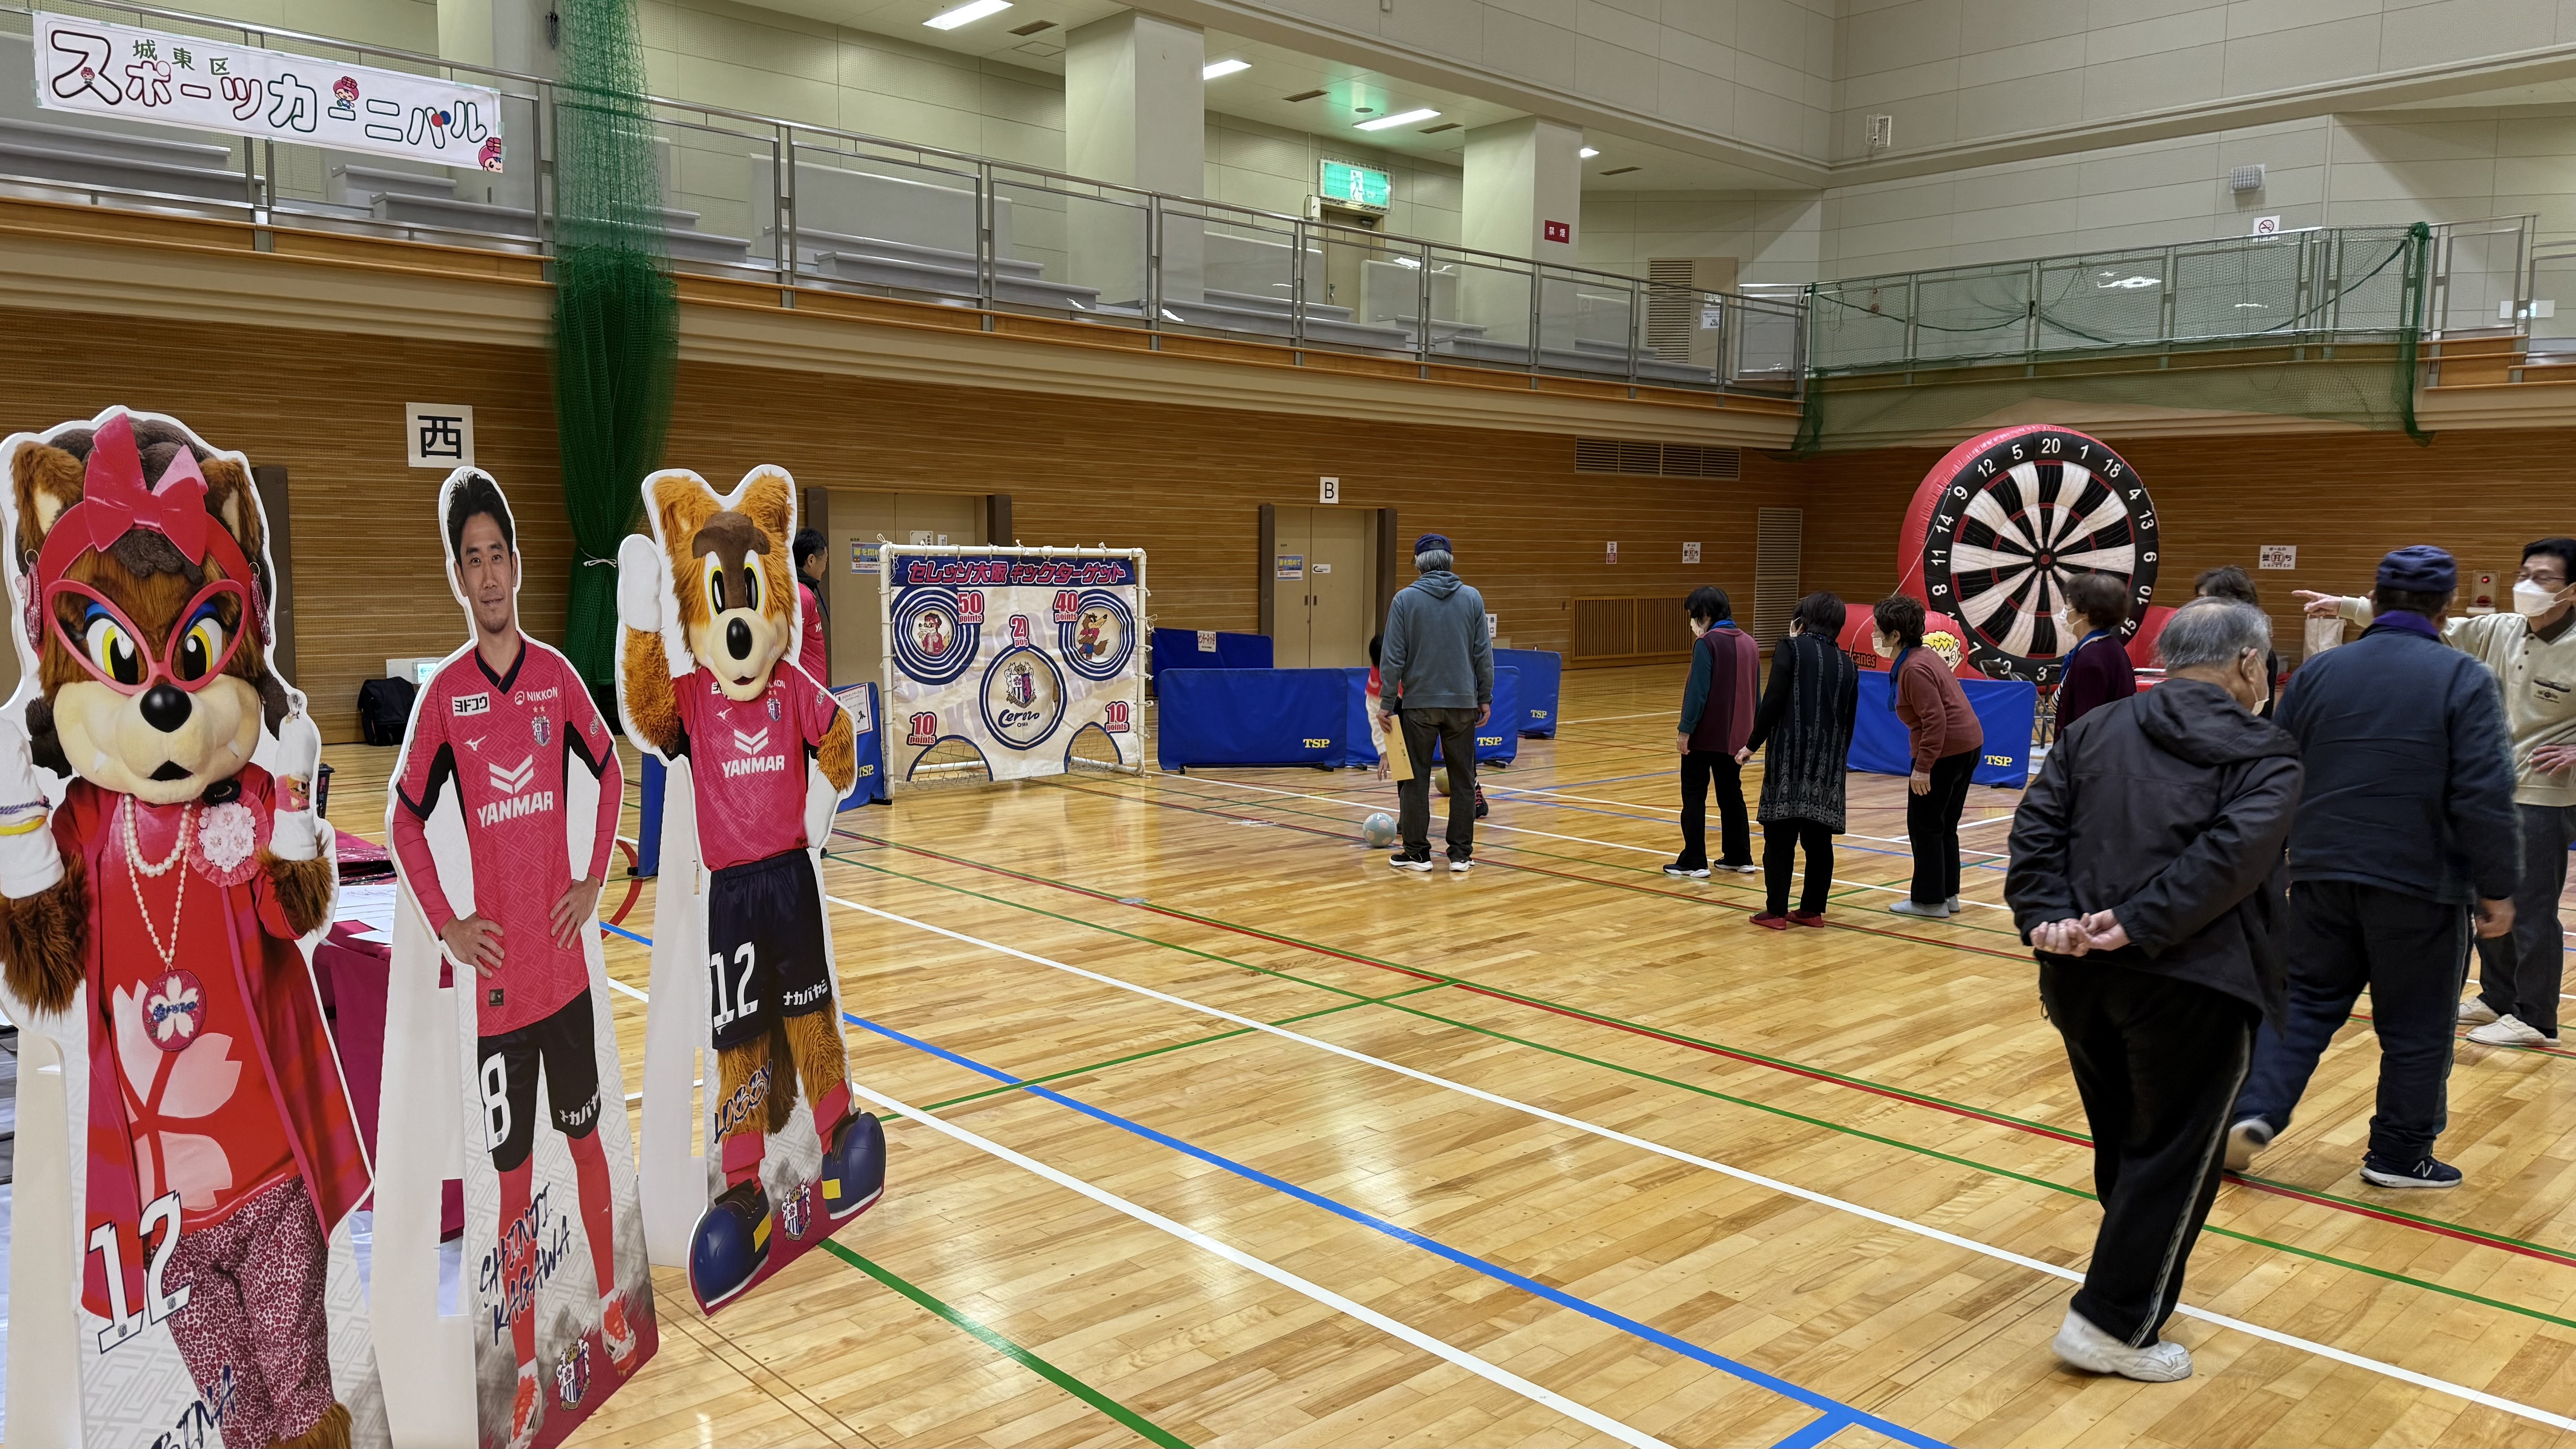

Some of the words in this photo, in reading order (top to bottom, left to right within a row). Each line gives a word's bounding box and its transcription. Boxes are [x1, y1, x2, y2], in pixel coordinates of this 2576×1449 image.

[133, 39, 230, 76] 城東区
[418, 415, 462, 459] 西
[2012, 445, 2024, 459] 5
[2042, 438, 2061, 454] 20
[2080, 445, 2088, 460] 1
[1978, 460, 1996, 478] 12
[2104, 459, 2121, 478] 18
[1325, 482, 1334, 499] B
[1954, 486, 1968, 500] 9
[2128, 488, 2141, 500] 4
[1936, 514, 1954, 534] 14
[2140, 511, 2153, 529] 13
[1932, 550, 1946, 565] 11
[2144, 552, 2157, 563] 6
[1010, 561, 1125, 584] キックターゲット
[1932, 584, 1947, 595] 8
[2137, 586, 2151, 604] 10
[957, 592, 982, 614] 50
[1054, 592, 1078, 613] 40
[959, 614, 982, 623] points
[1055, 612, 1077, 621] points
[2121, 618, 2137, 636] 15
[1968, 642, 1982, 654] 7
[2037, 667, 2047, 681] 3
[527, 686, 558, 702] NIKKON
[455, 696, 488, 713] ヨドコウ
[1106, 703, 1127, 723] 10
[998, 709, 1040, 728] Cerezo
[1531, 709, 1547, 718] TSP
[912, 714, 935, 736] 10
[1106, 723, 1128, 731] points
[910, 736, 935, 744] points
[1303, 739, 1330, 748] TSP
[1478, 737, 1502, 745] TSP
[722, 755, 785, 778] YANMAR
[1984, 755, 2012, 766] TSP
[477, 790, 554, 829] YANMAR
[710, 941, 758, 1028] 12
[480, 1051, 512, 1153] 8
[479, 1182, 552, 1308] SHINJI
[88, 1190, 192, 1354] 12
[493, 1215, 570, 1346] KAGAWA
